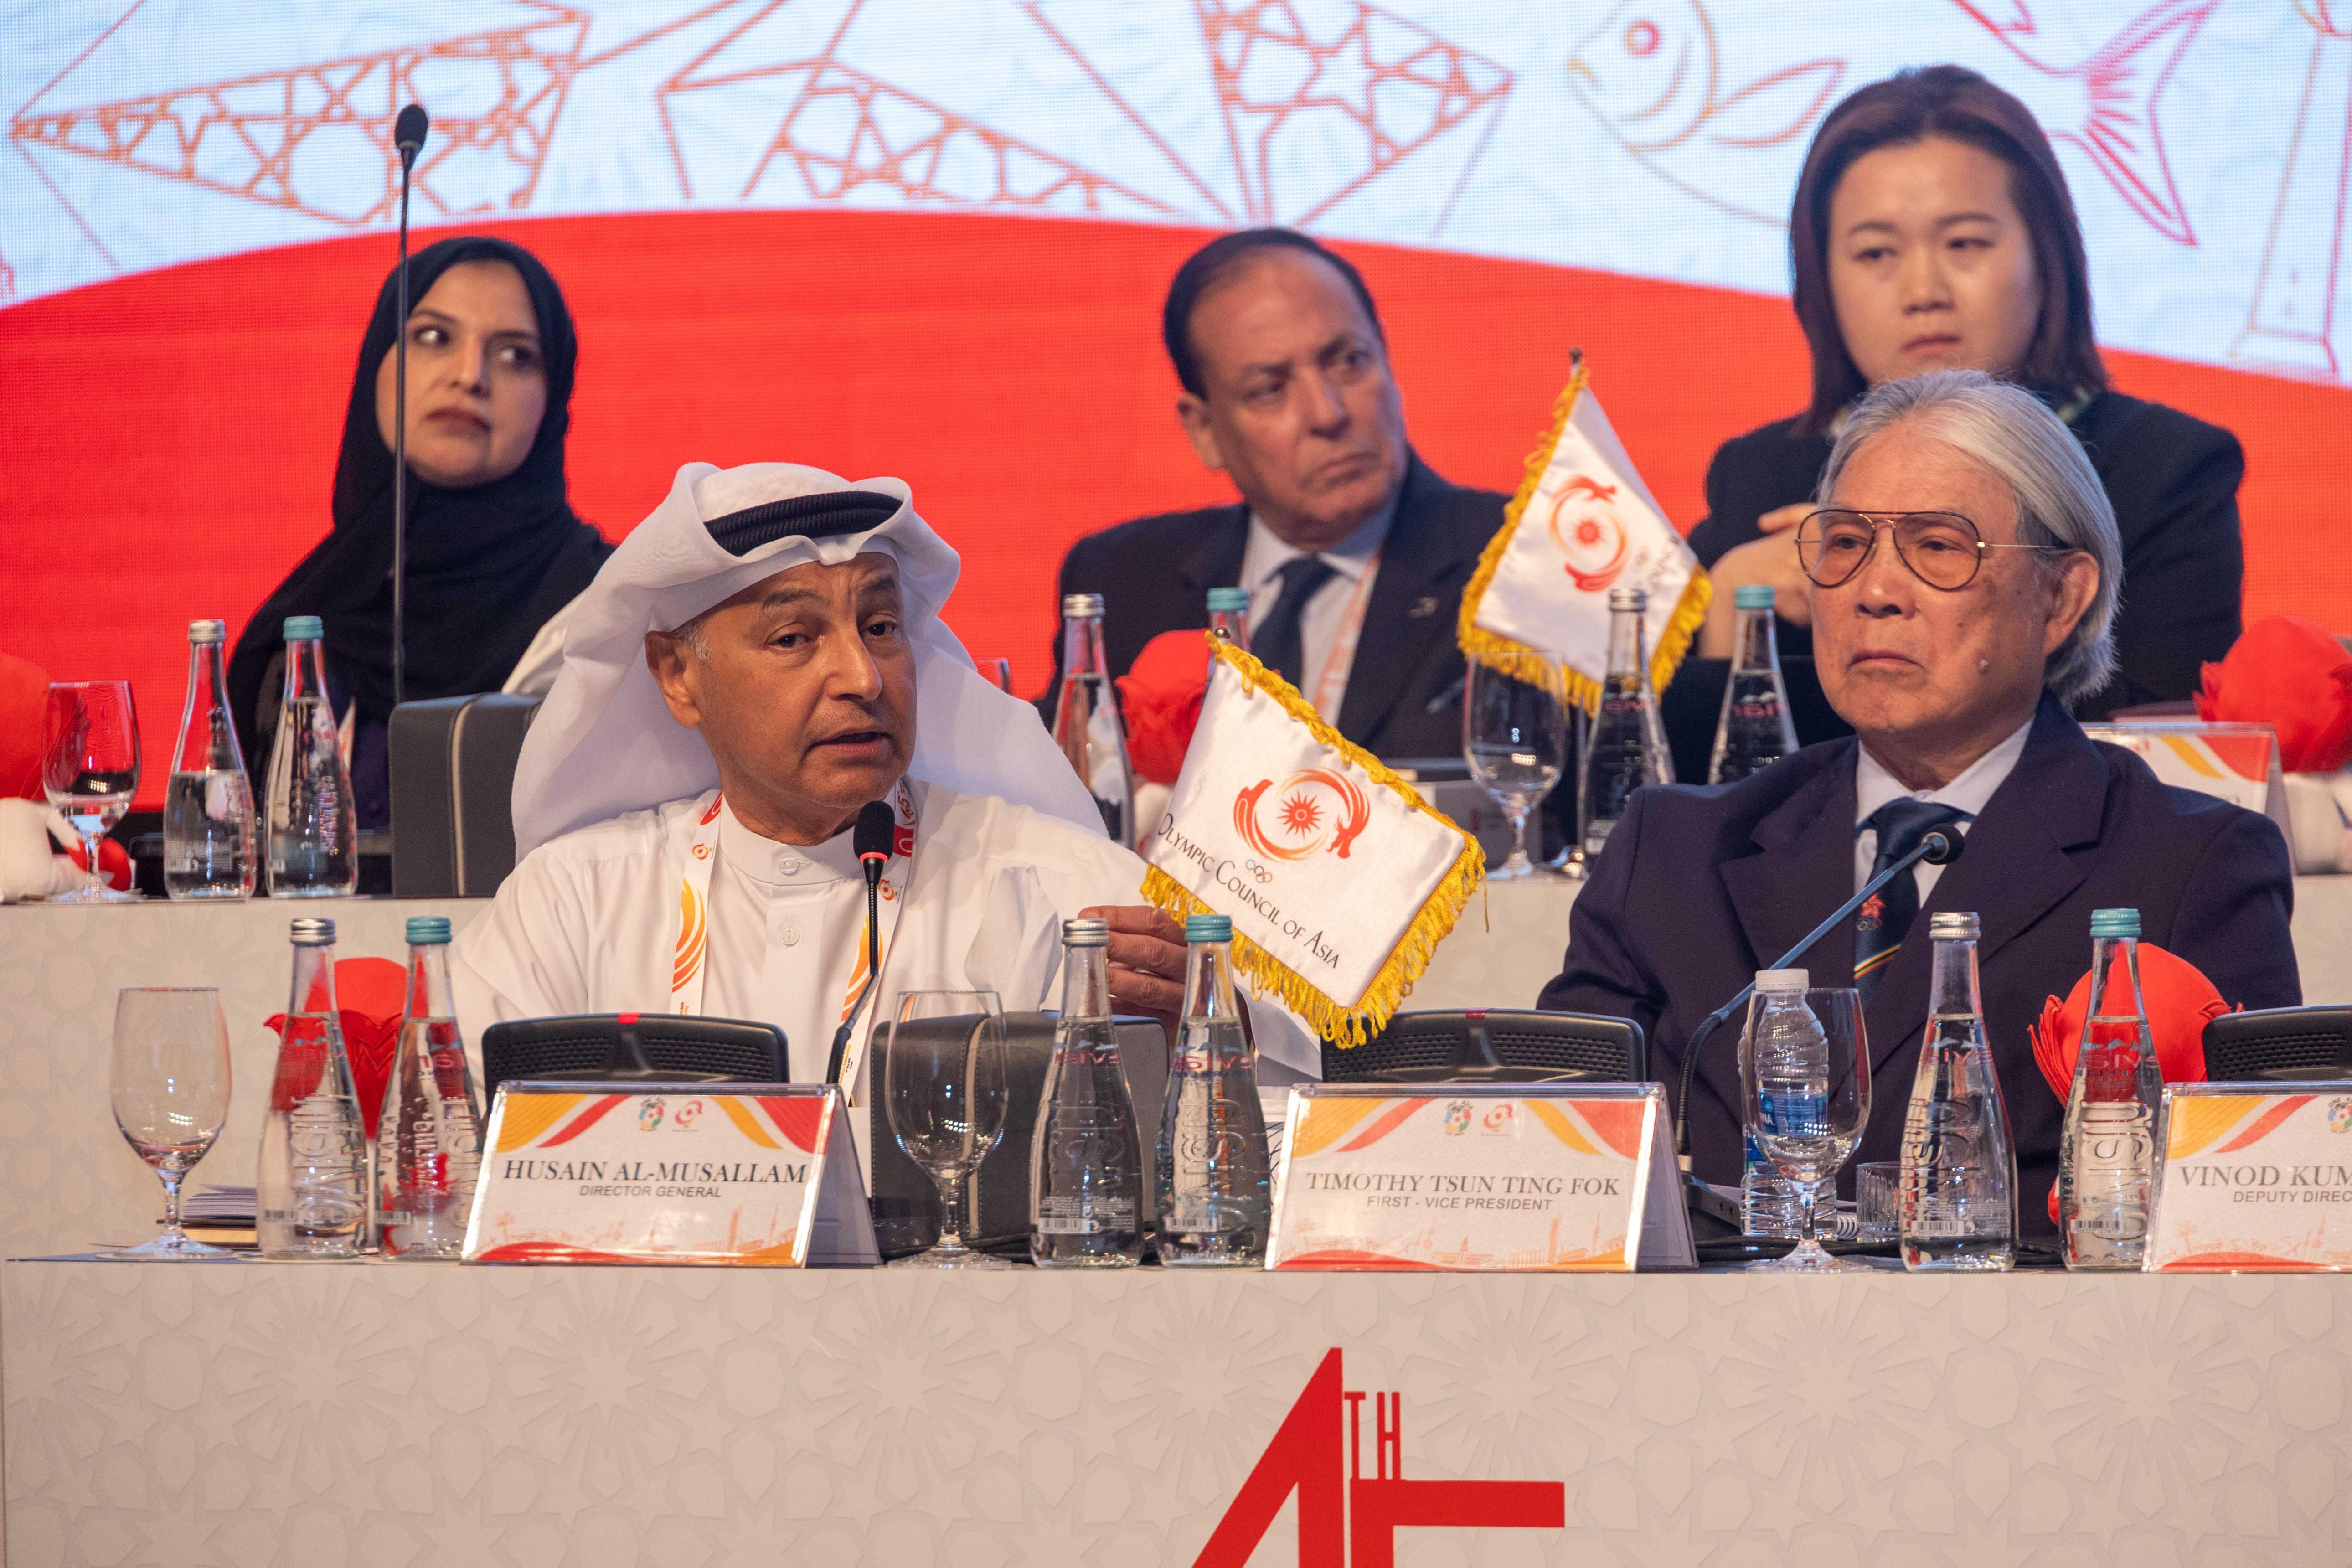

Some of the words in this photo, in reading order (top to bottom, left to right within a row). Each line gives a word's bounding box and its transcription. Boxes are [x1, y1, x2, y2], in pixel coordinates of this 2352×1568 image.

[503, 1160, 607, 1181] HUSAIN
[612, 1161, 807, 1183] AL-MUSALLAM
[2179, 1166, 2280, 1186] VINOD
[579, 1185, 651, 1197] DIRECTOR
[656, 1186, 722, 1198] GENERAL
[1306, 1172, 1425, 1192] TIMOTHY
[1429, 1174, 1497, 1193] TSUN
[1502, 1176, 1565, 1195] TING
[1571, 1178, 1619, 1195] FOK
[1367, 1195, 1409, 1208] FIRST
[1425, 1197, 1460, 1209] VICE
[1465, 1197, 1553, 1211] PRESIDENT
[2233, 1191, 2299, 1203] DEPUTY
[2303, 1191, 2352, 1202] DIREC
